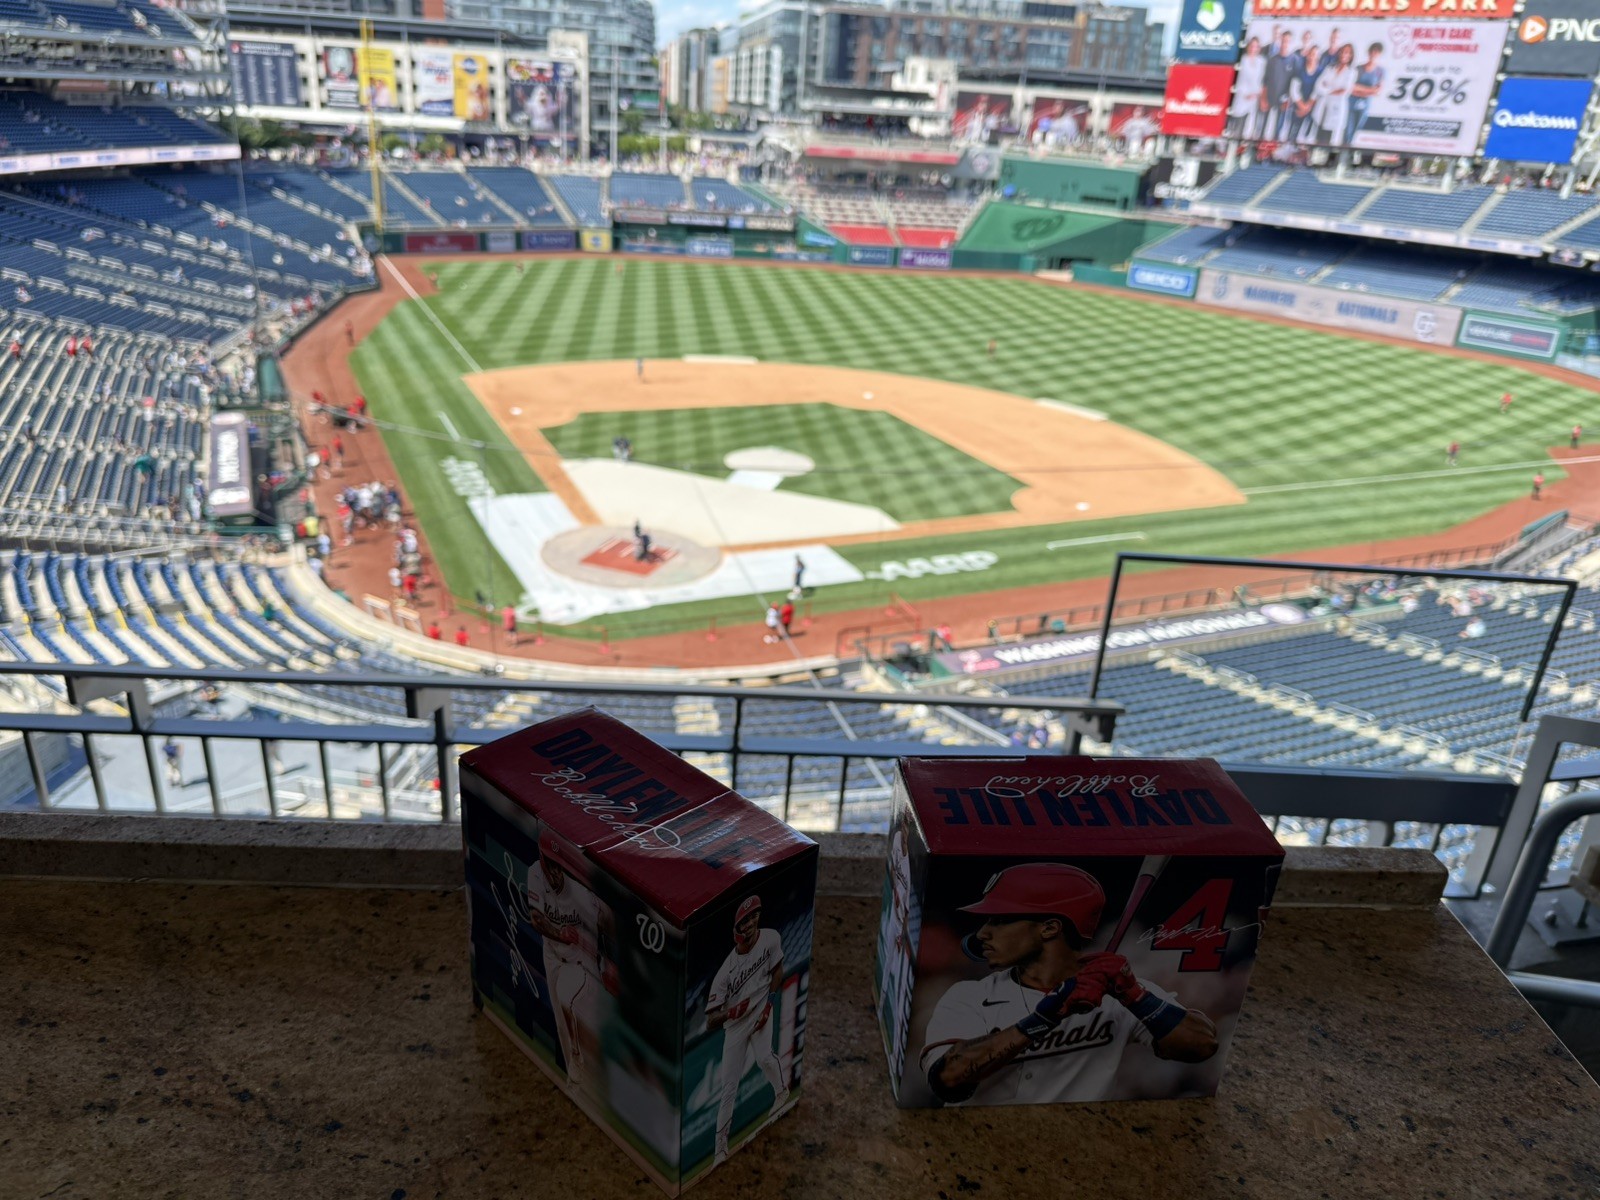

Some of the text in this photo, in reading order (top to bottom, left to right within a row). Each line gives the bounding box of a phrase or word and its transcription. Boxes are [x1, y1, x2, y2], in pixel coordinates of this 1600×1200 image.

[1259, 0, 1499, 12] NATIONALS PARK
[1546, 17, 1600, 42] PNC
[1387, 77, 1471, 105] 30%
[1493, 108, 1578, 130] Qualcomm
[1336, 300, 1399, 324] NATIONALS
[1146, 610, 1270, 643] NATIONALS
[530, 728, 691, 825] DAYLEN
[968, 774, 1161, 798] Bobblehead
[530, 766, 690, 855] Bobblehead
[933, 787, 1233, 827] DAYLEN LILE
[1150, 875, 1236, 973] 4
[724, 947, 771, 1000] Nationals
